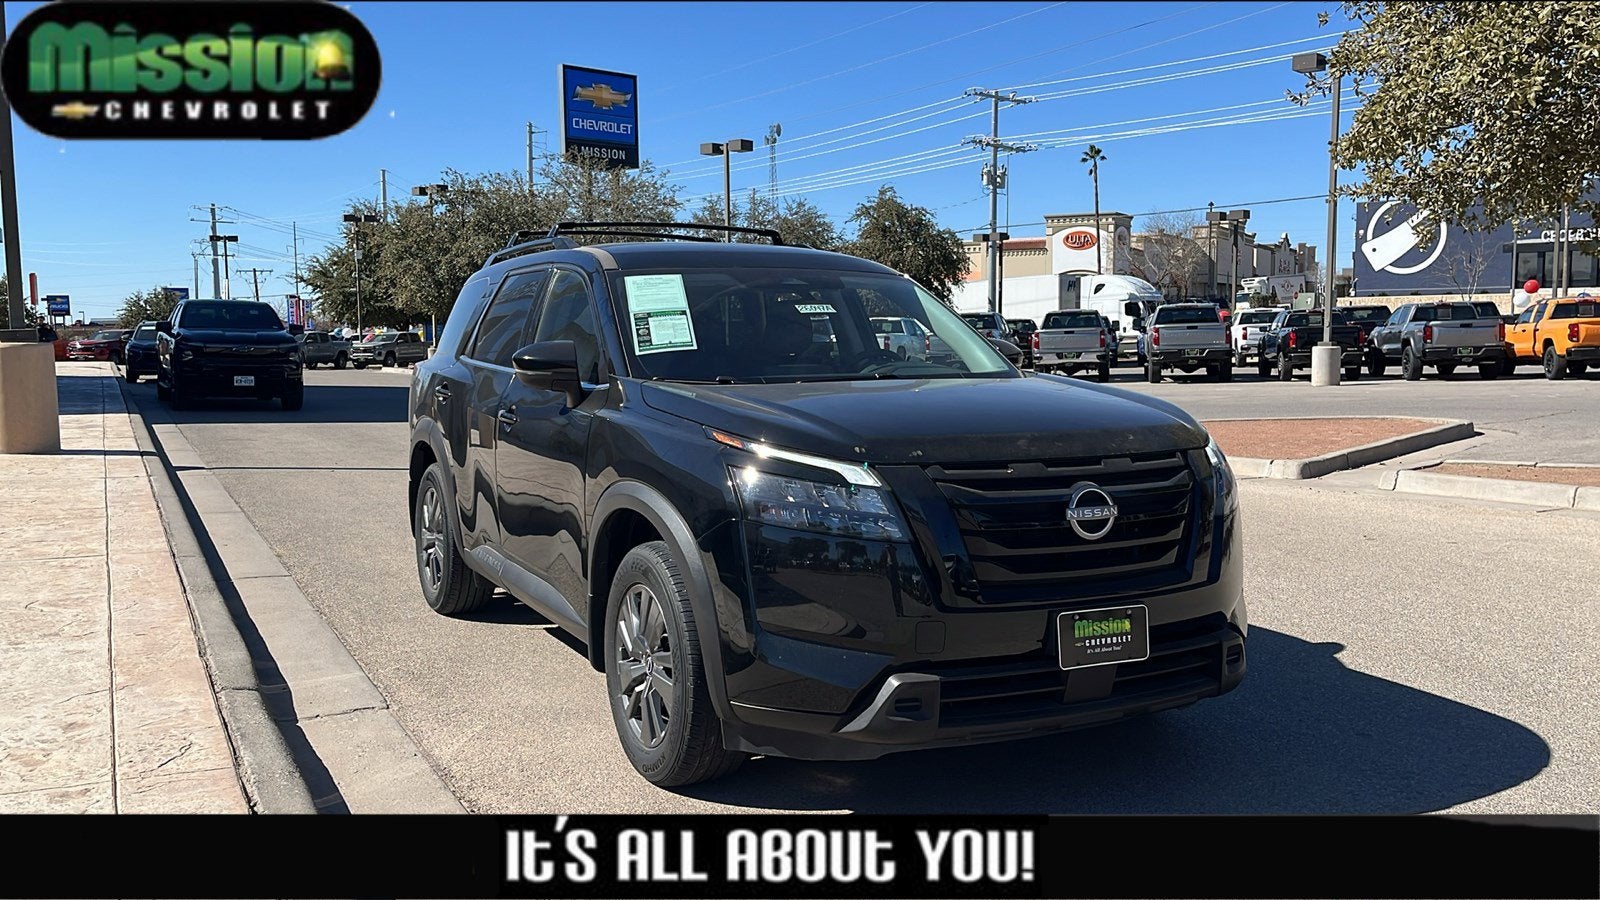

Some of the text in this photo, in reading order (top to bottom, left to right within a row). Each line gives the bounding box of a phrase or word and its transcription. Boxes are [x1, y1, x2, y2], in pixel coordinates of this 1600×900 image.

[573, 118, 632, 134] CHEVROLET
[581, 147, 626, 160] MISSION
[1067, 233, 1092, 247] ULTA
[1067, 507, 1118, 518] NISSAN
[1074, 618, 1131, 638] Mission
[1085, 635, 1132, 646] CHEVROLET
